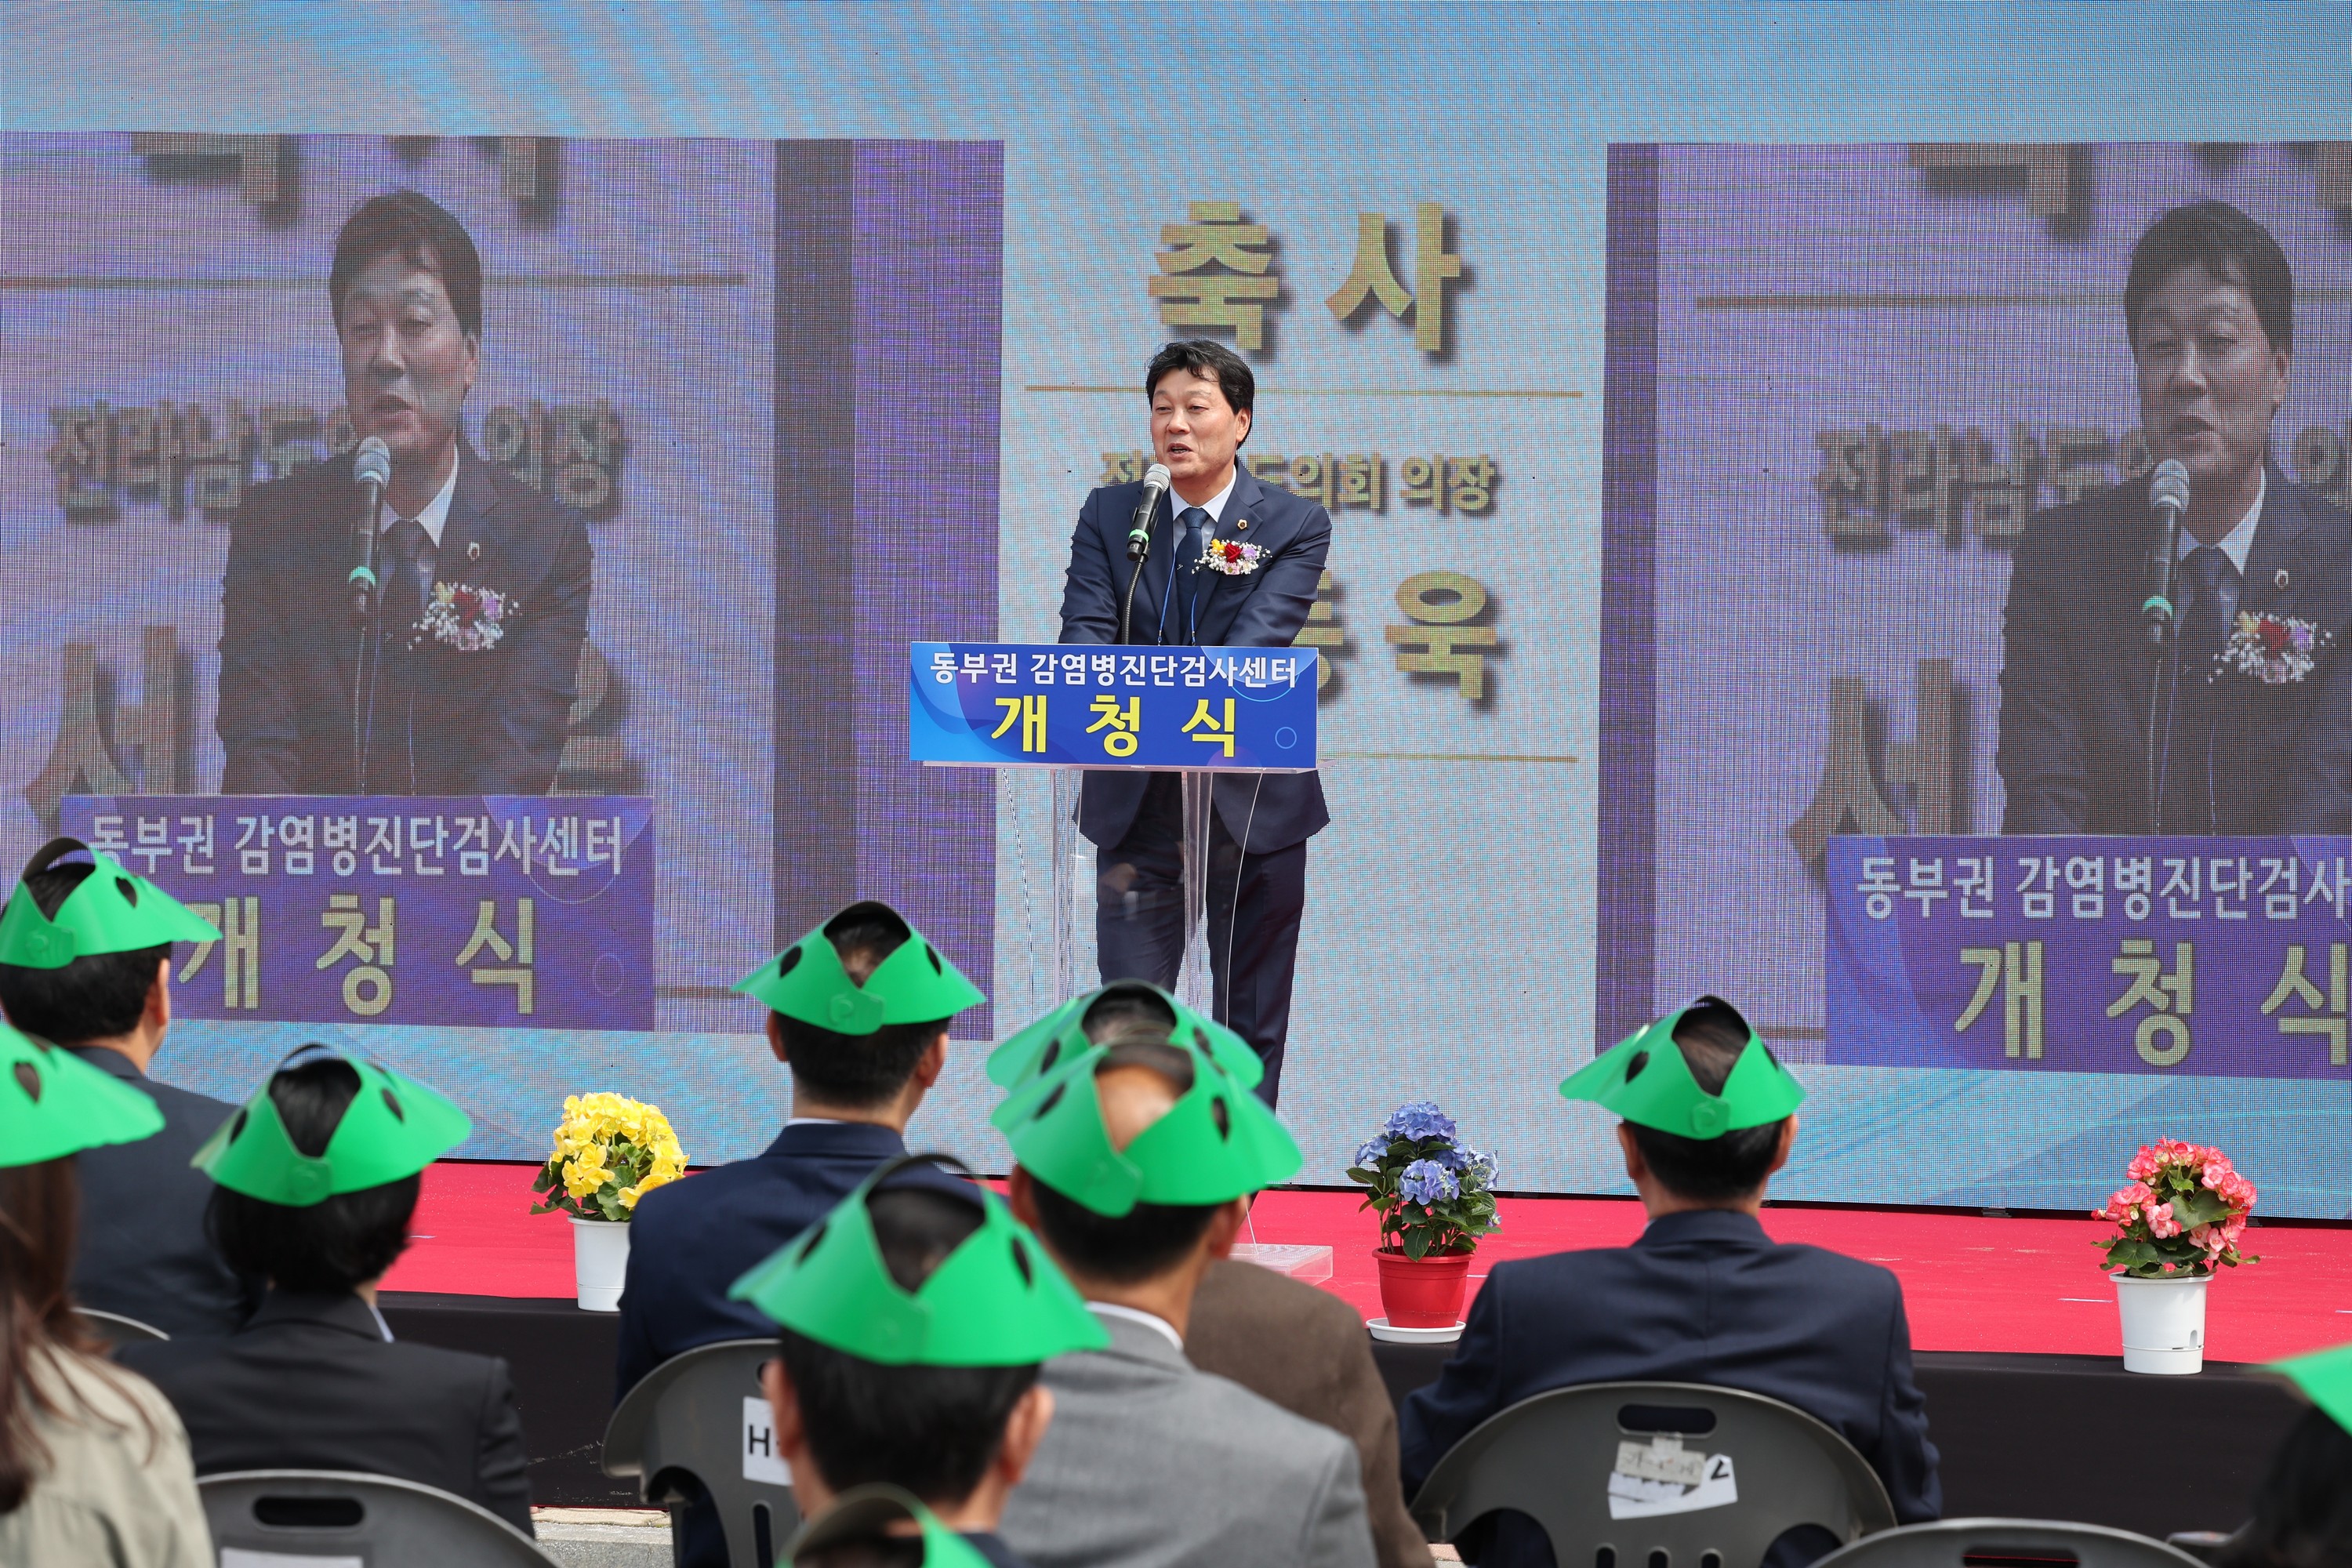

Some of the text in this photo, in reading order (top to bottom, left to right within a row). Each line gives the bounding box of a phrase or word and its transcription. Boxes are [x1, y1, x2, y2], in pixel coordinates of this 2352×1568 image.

[1148, 201, 1461, 352] 축 사
[47, 398, 357, 511] 전라남도
[1400, 453, 1496, 511] 의장
[1814, 423, 2154, 536] 전라남도
[1385, 571, 1497, 699] 욱
[930, 653, 1297, 689] 동부권 감염병진단검사센터
[89, 814, 622, 877] 동부권 감염병진단검사센터
[1857, 856, 1994, 920] 동부권
[748, 1424, 780, 1457] H
